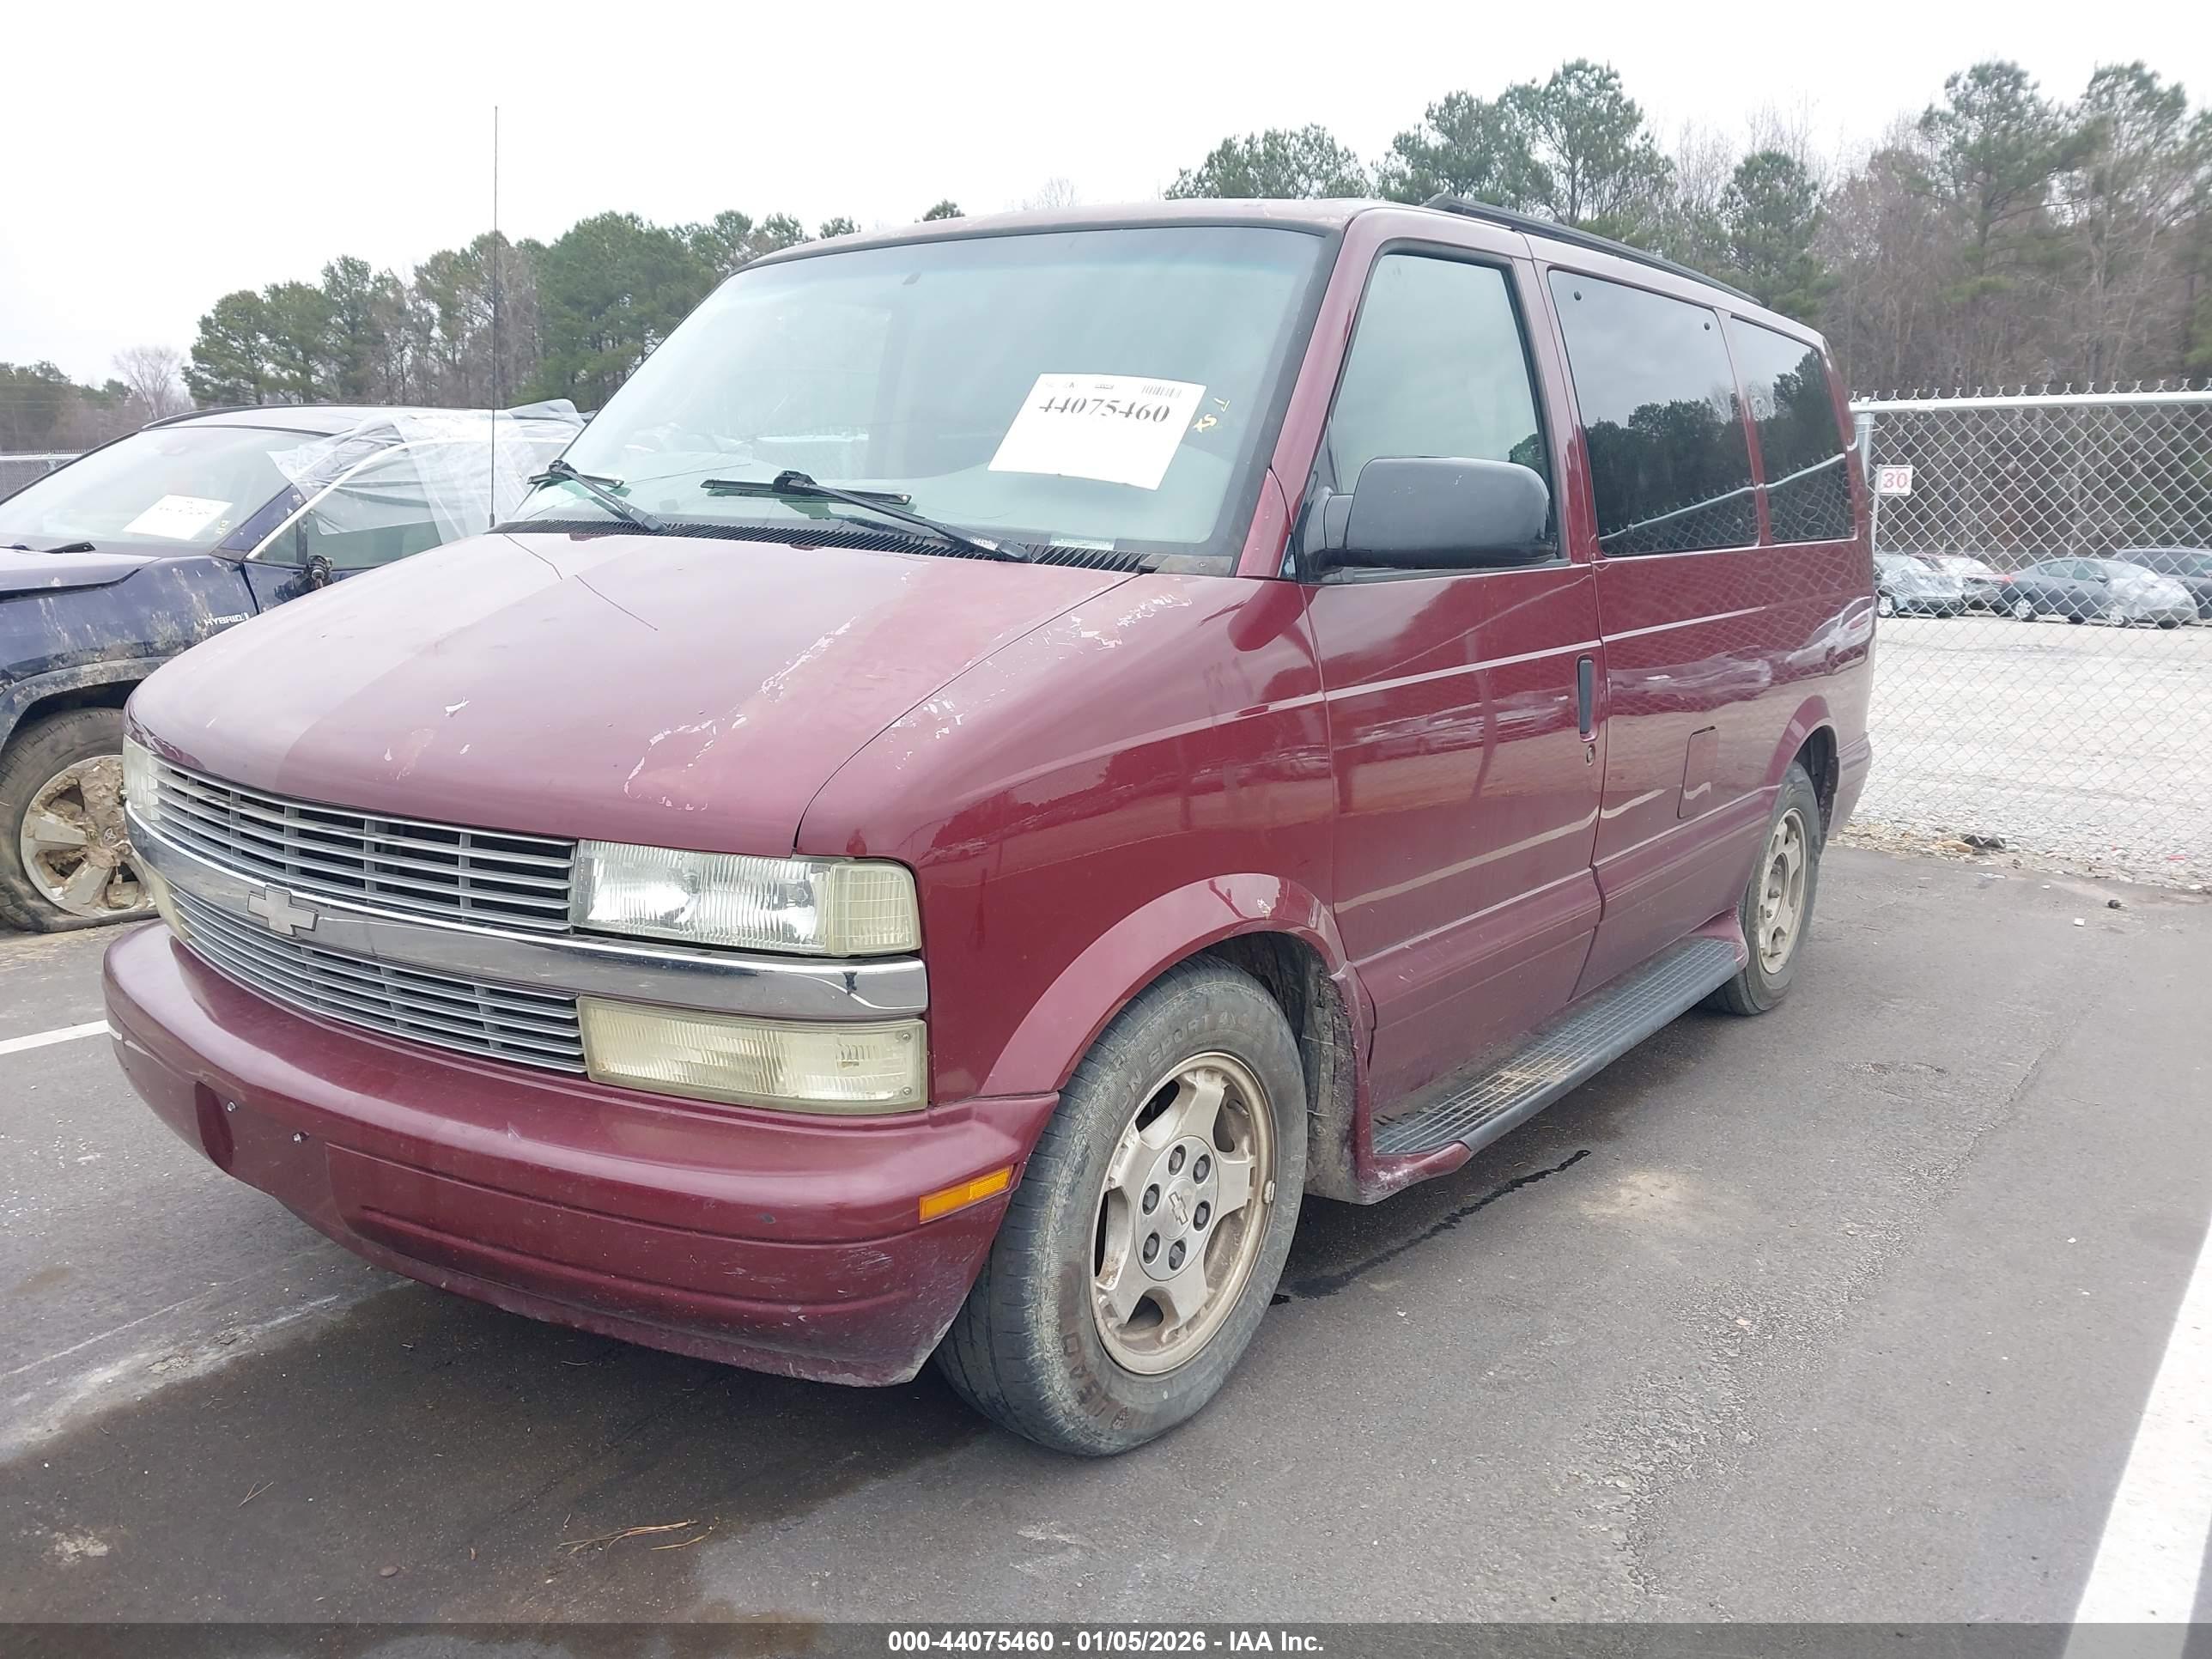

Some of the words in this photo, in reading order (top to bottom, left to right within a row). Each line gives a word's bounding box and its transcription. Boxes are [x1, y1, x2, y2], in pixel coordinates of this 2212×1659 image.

[1038, 397, 1171, 423] 44075460
[1883, 472, 1908, 489] 30
[204, 613, 243, 626] HYBRID
[1147, 1013, 1211, 1065] SPORT
